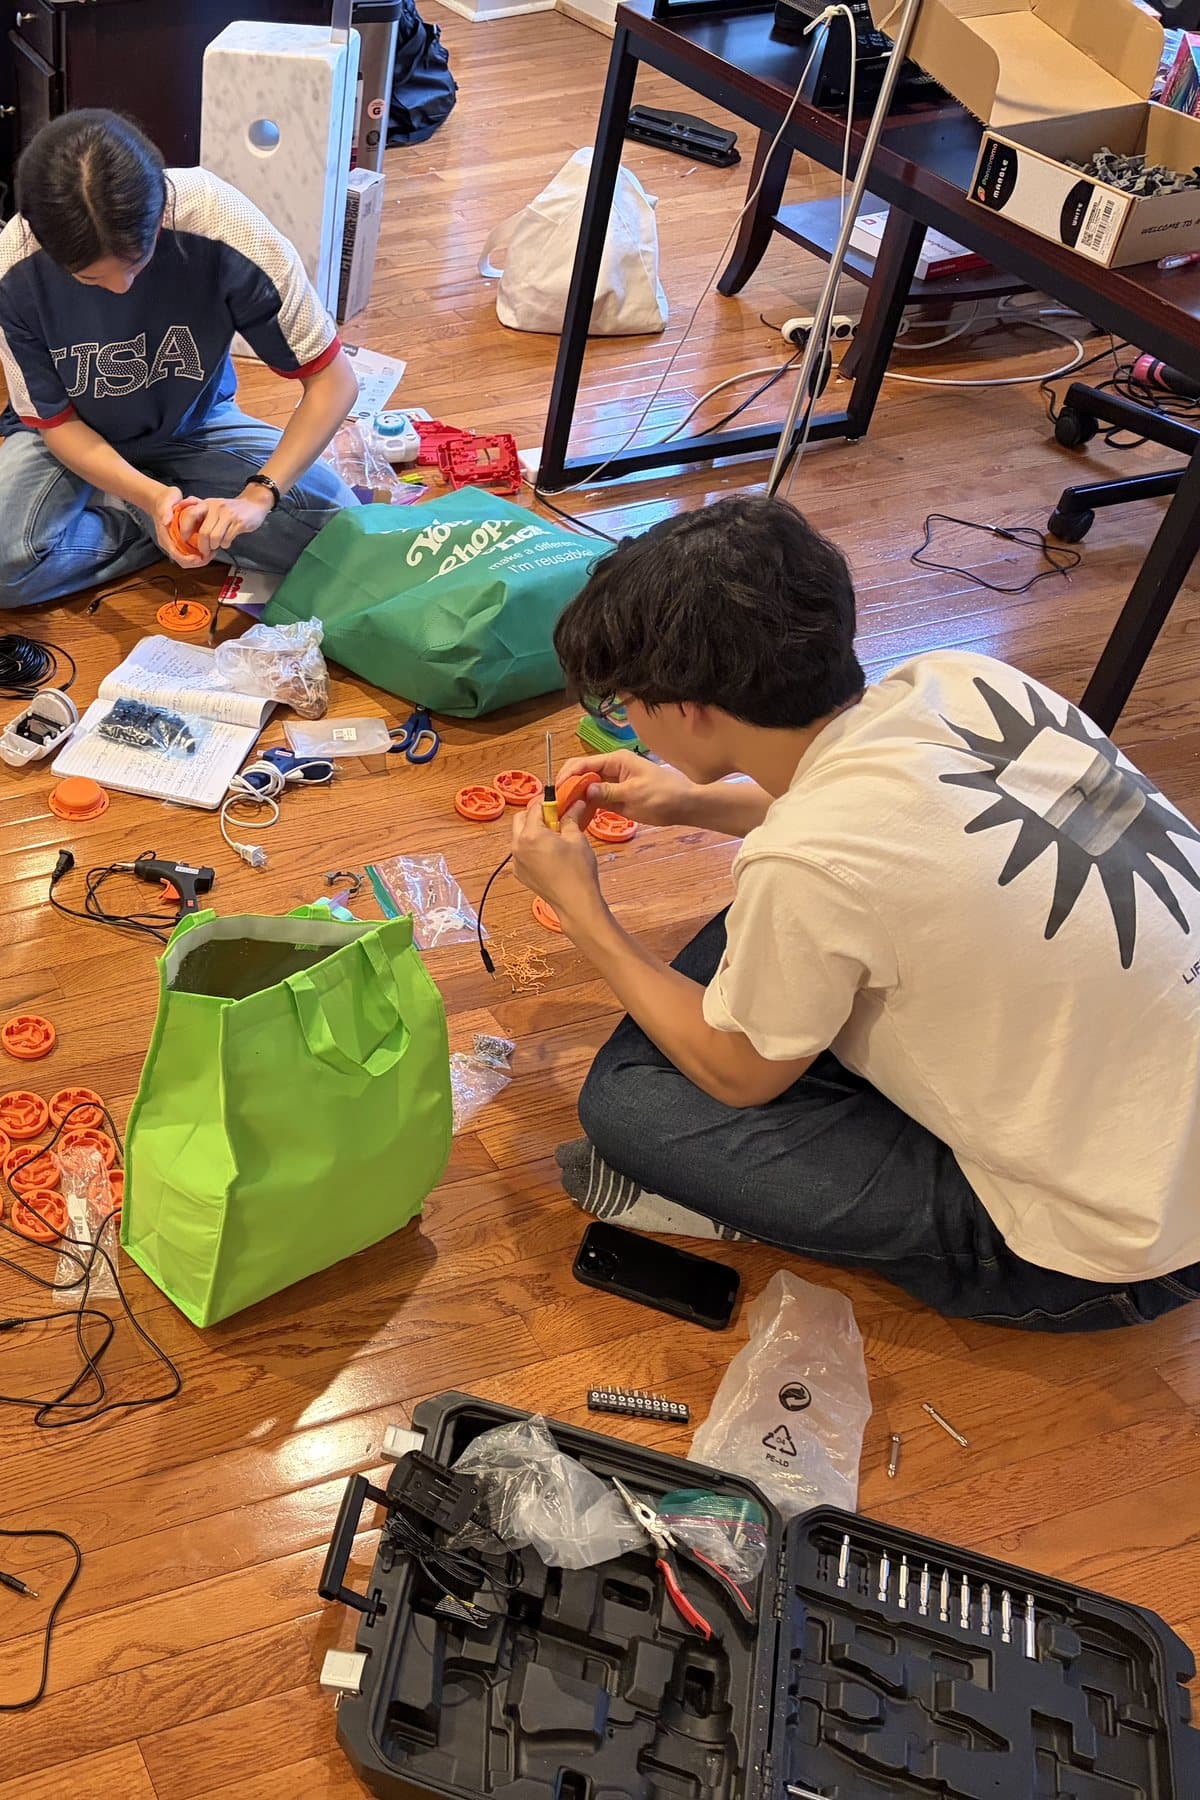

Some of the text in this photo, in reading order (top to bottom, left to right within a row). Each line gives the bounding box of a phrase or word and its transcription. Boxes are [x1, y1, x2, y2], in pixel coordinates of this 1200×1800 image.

[1141, 219, 1193, 234] WELCOME TO
[50, 325, 205, 398] USA
[488, 552, 524, 570] make
[507, 561, 535, 574] I'm
[766, 1453, 789, 1467] PE-LD
